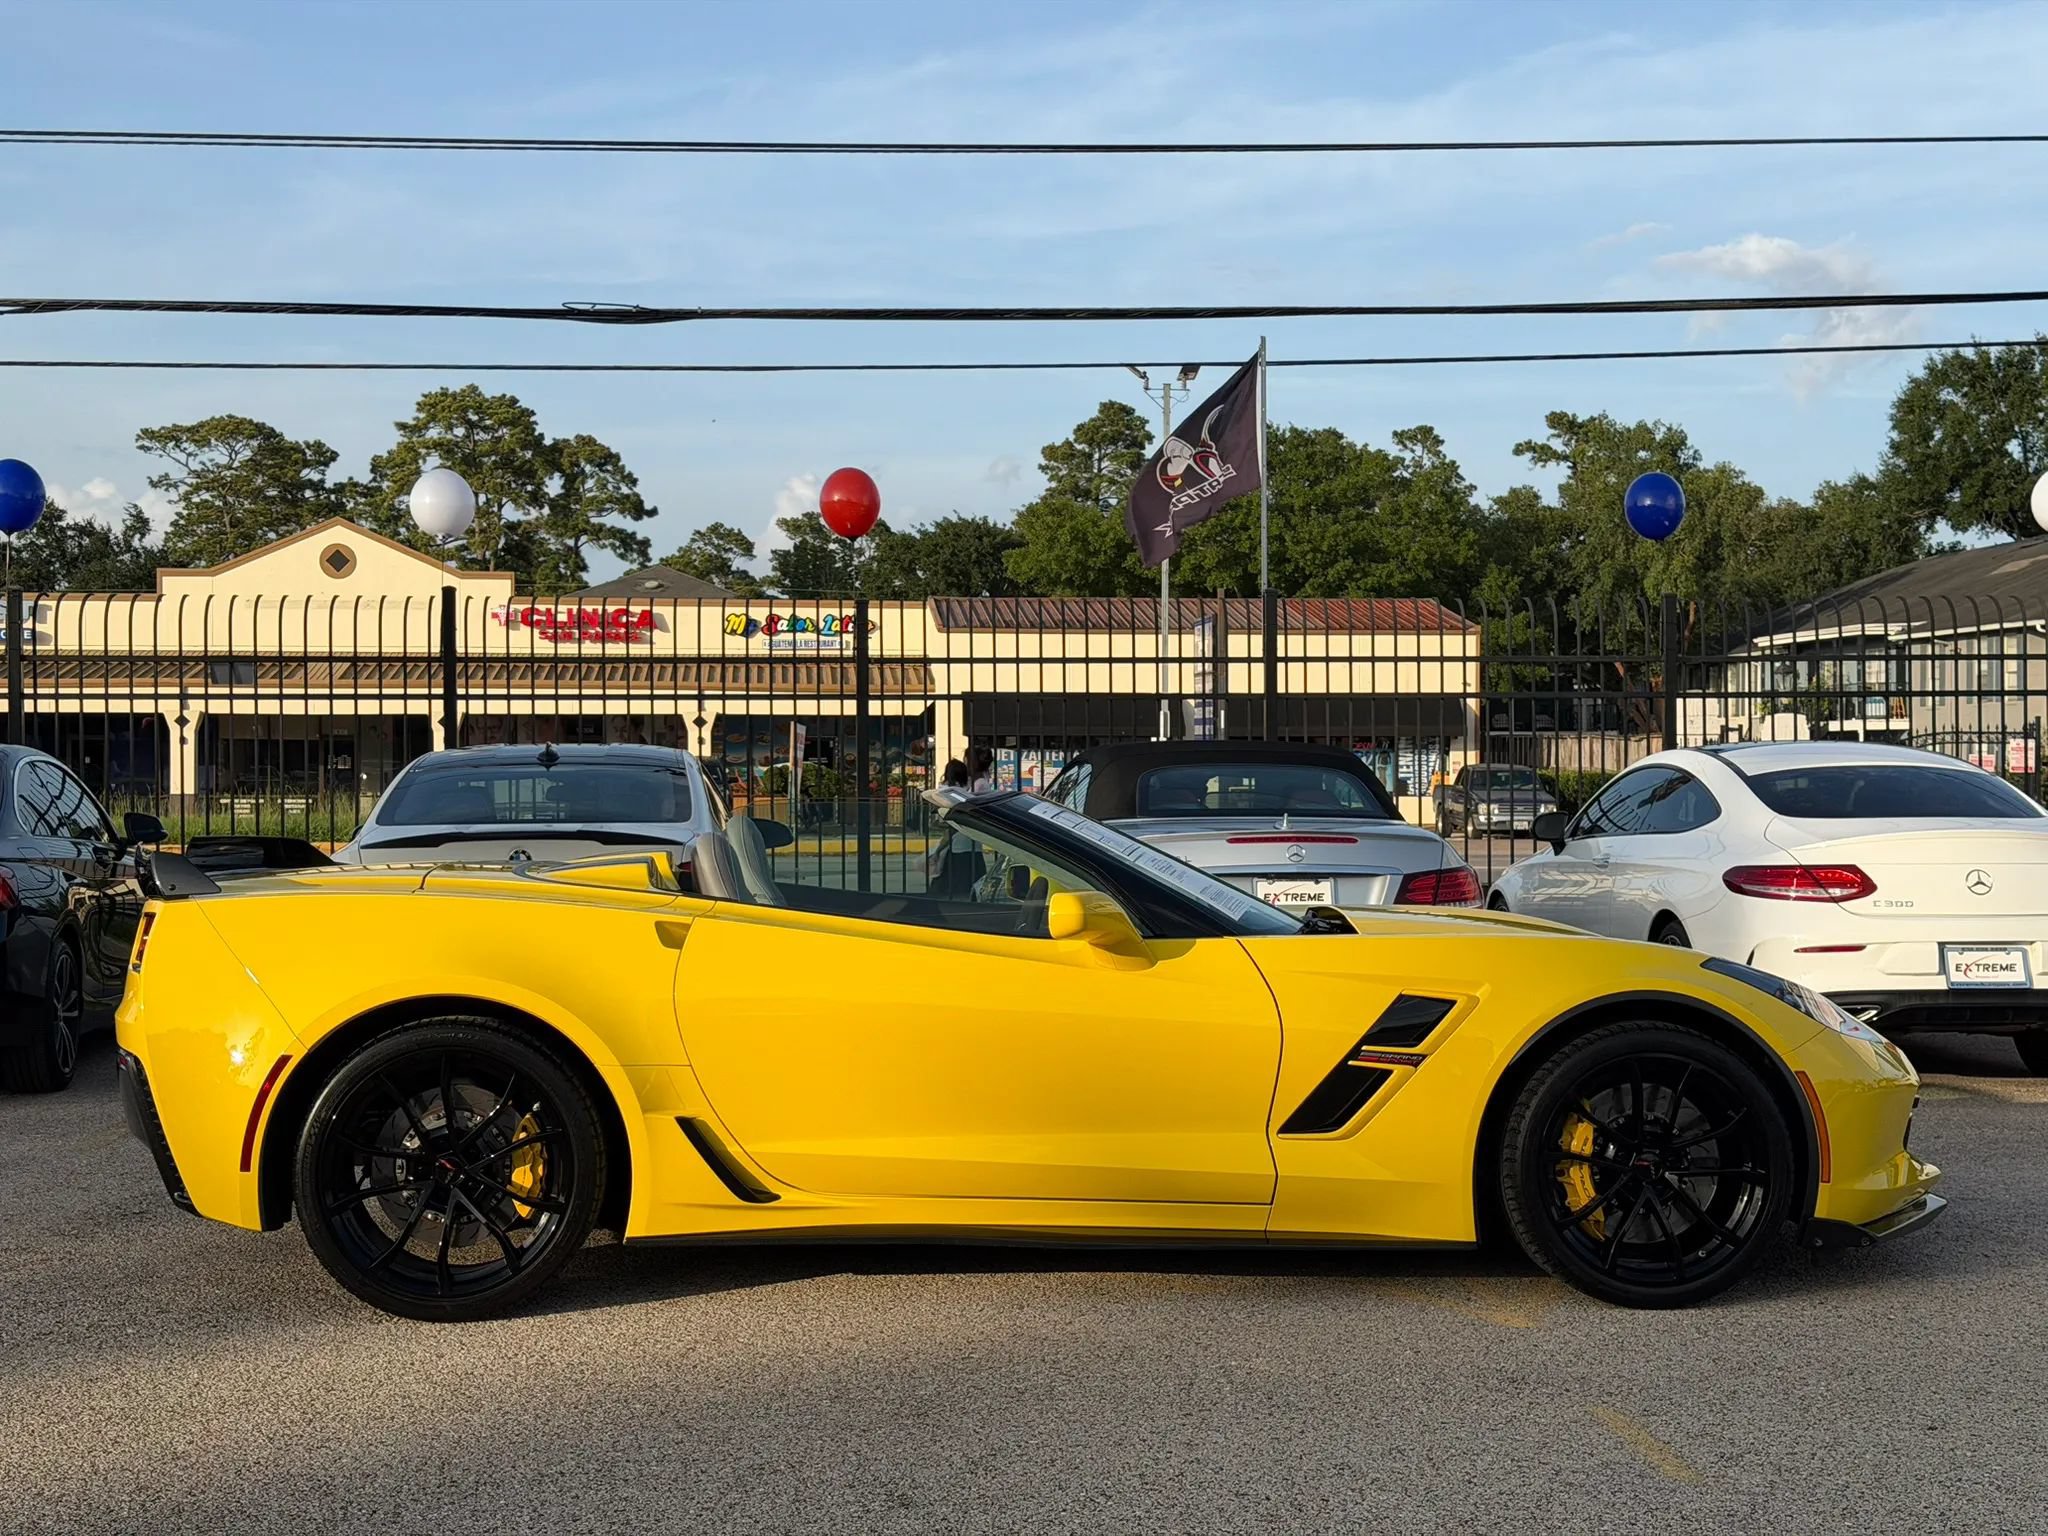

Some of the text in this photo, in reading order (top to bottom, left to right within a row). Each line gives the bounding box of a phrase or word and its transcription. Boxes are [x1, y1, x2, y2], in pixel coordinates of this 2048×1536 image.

[820, 613, 875, 636] Latio
[1263, 892, 1325, 902] EXTREME
[1955, 963, 2017, 973] EXTREME
